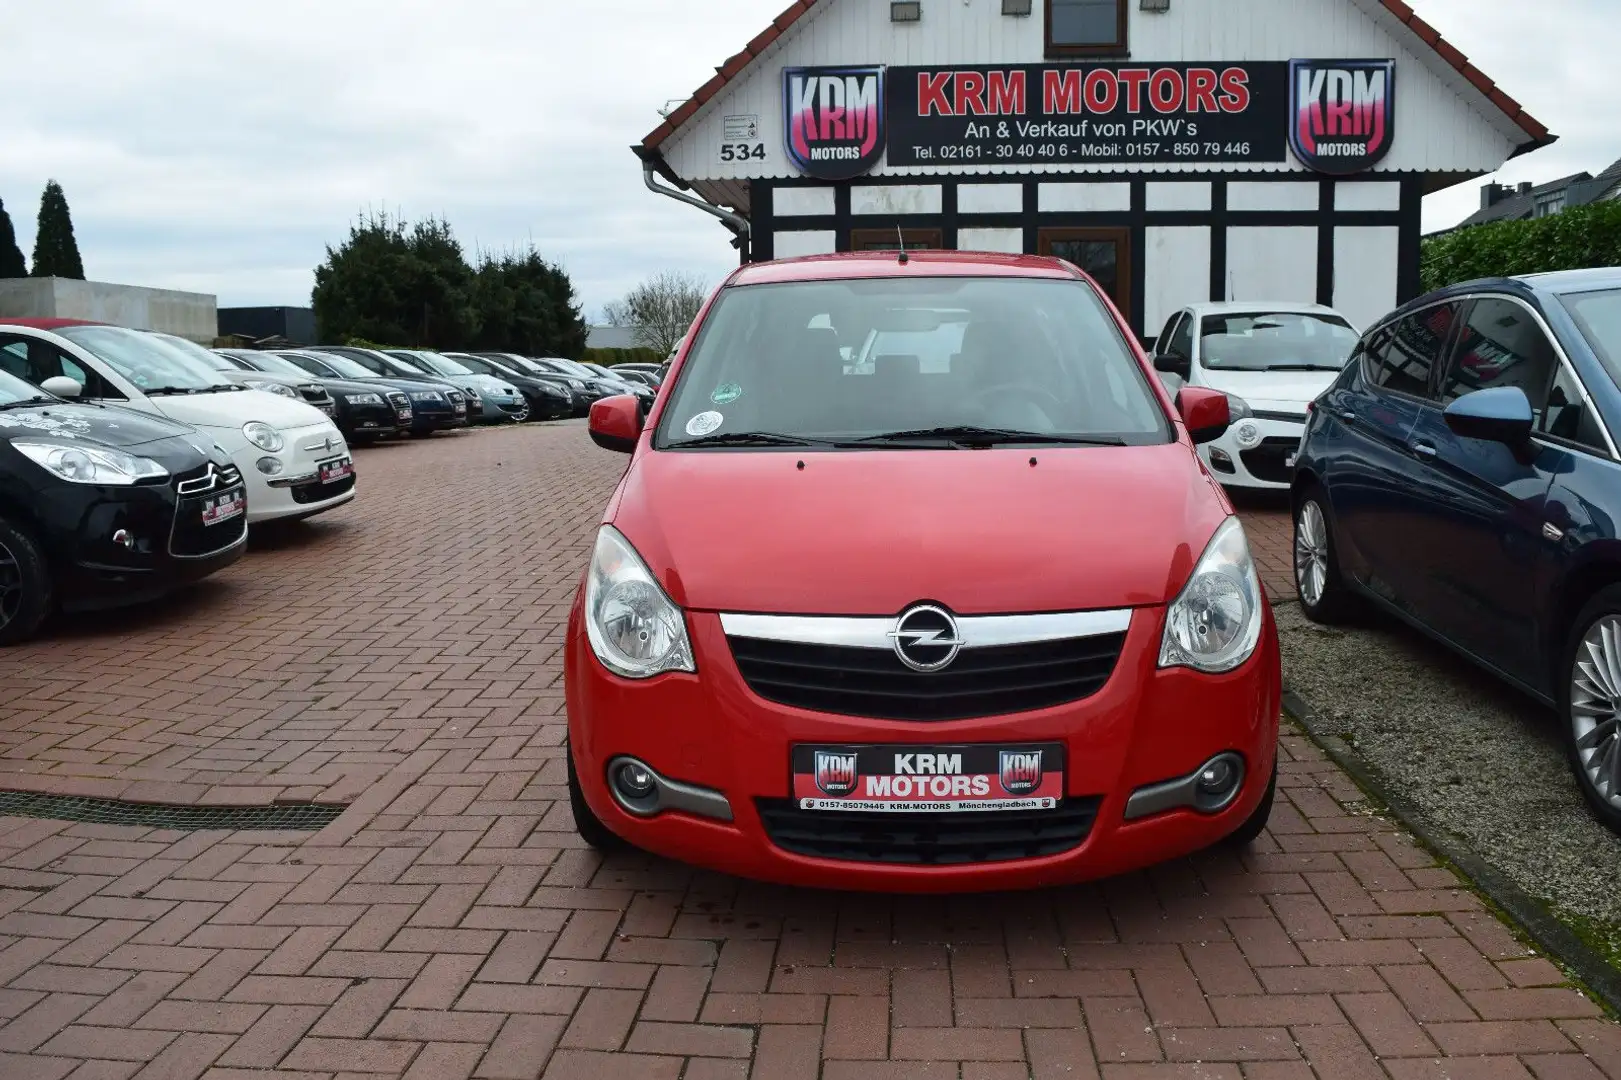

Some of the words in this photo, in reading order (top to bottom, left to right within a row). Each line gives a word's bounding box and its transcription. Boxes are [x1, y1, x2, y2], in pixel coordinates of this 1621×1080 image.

[917, 70, 1026, 117] KRM
[1043, 67, 1250, 115] MOTORS
[791, 76, 878, 159] KRM
[1299, 69, 1385, 155] KRM
[964, 121, 990, 138] An
[996, 121, 1010, 138] &
[1015, 120, 1088, 138] Verkauf
[1092, 123, 1126, 137] von
[720, 143, 766, 161] 534
[811, 147, 860, 160] MOTORS
[912, 146, 936, 159] Tel.
[940, 145, 982, 159] 02161
[995, 145, 1013, 157] 30
[1016, 144, 1034, 157] 40
[1037, 144, 1055, 157] 40
[1059, 144, 1068, 156] 6
[1081, 143, 1122, 156] Mobil:
[1126, 142, 1160, 156] 0157
[1173, 142, 1199, 155] 850
[1203, 142, 1221, 155] 79
[1224, 142, 1250, 155] 446
[1316, 143, 1366, 156] MOTORS
[818, 755, 856, 790] KRM
[894, 753, 962, 775] KRM
[1002, 753, 1039, 788] KRM
[866, 774, 990, 797] MOTORS
[890, 802, 951, 810] KRM-MOTORS
[958, 800, 1037, 810] Mönchengladbach
